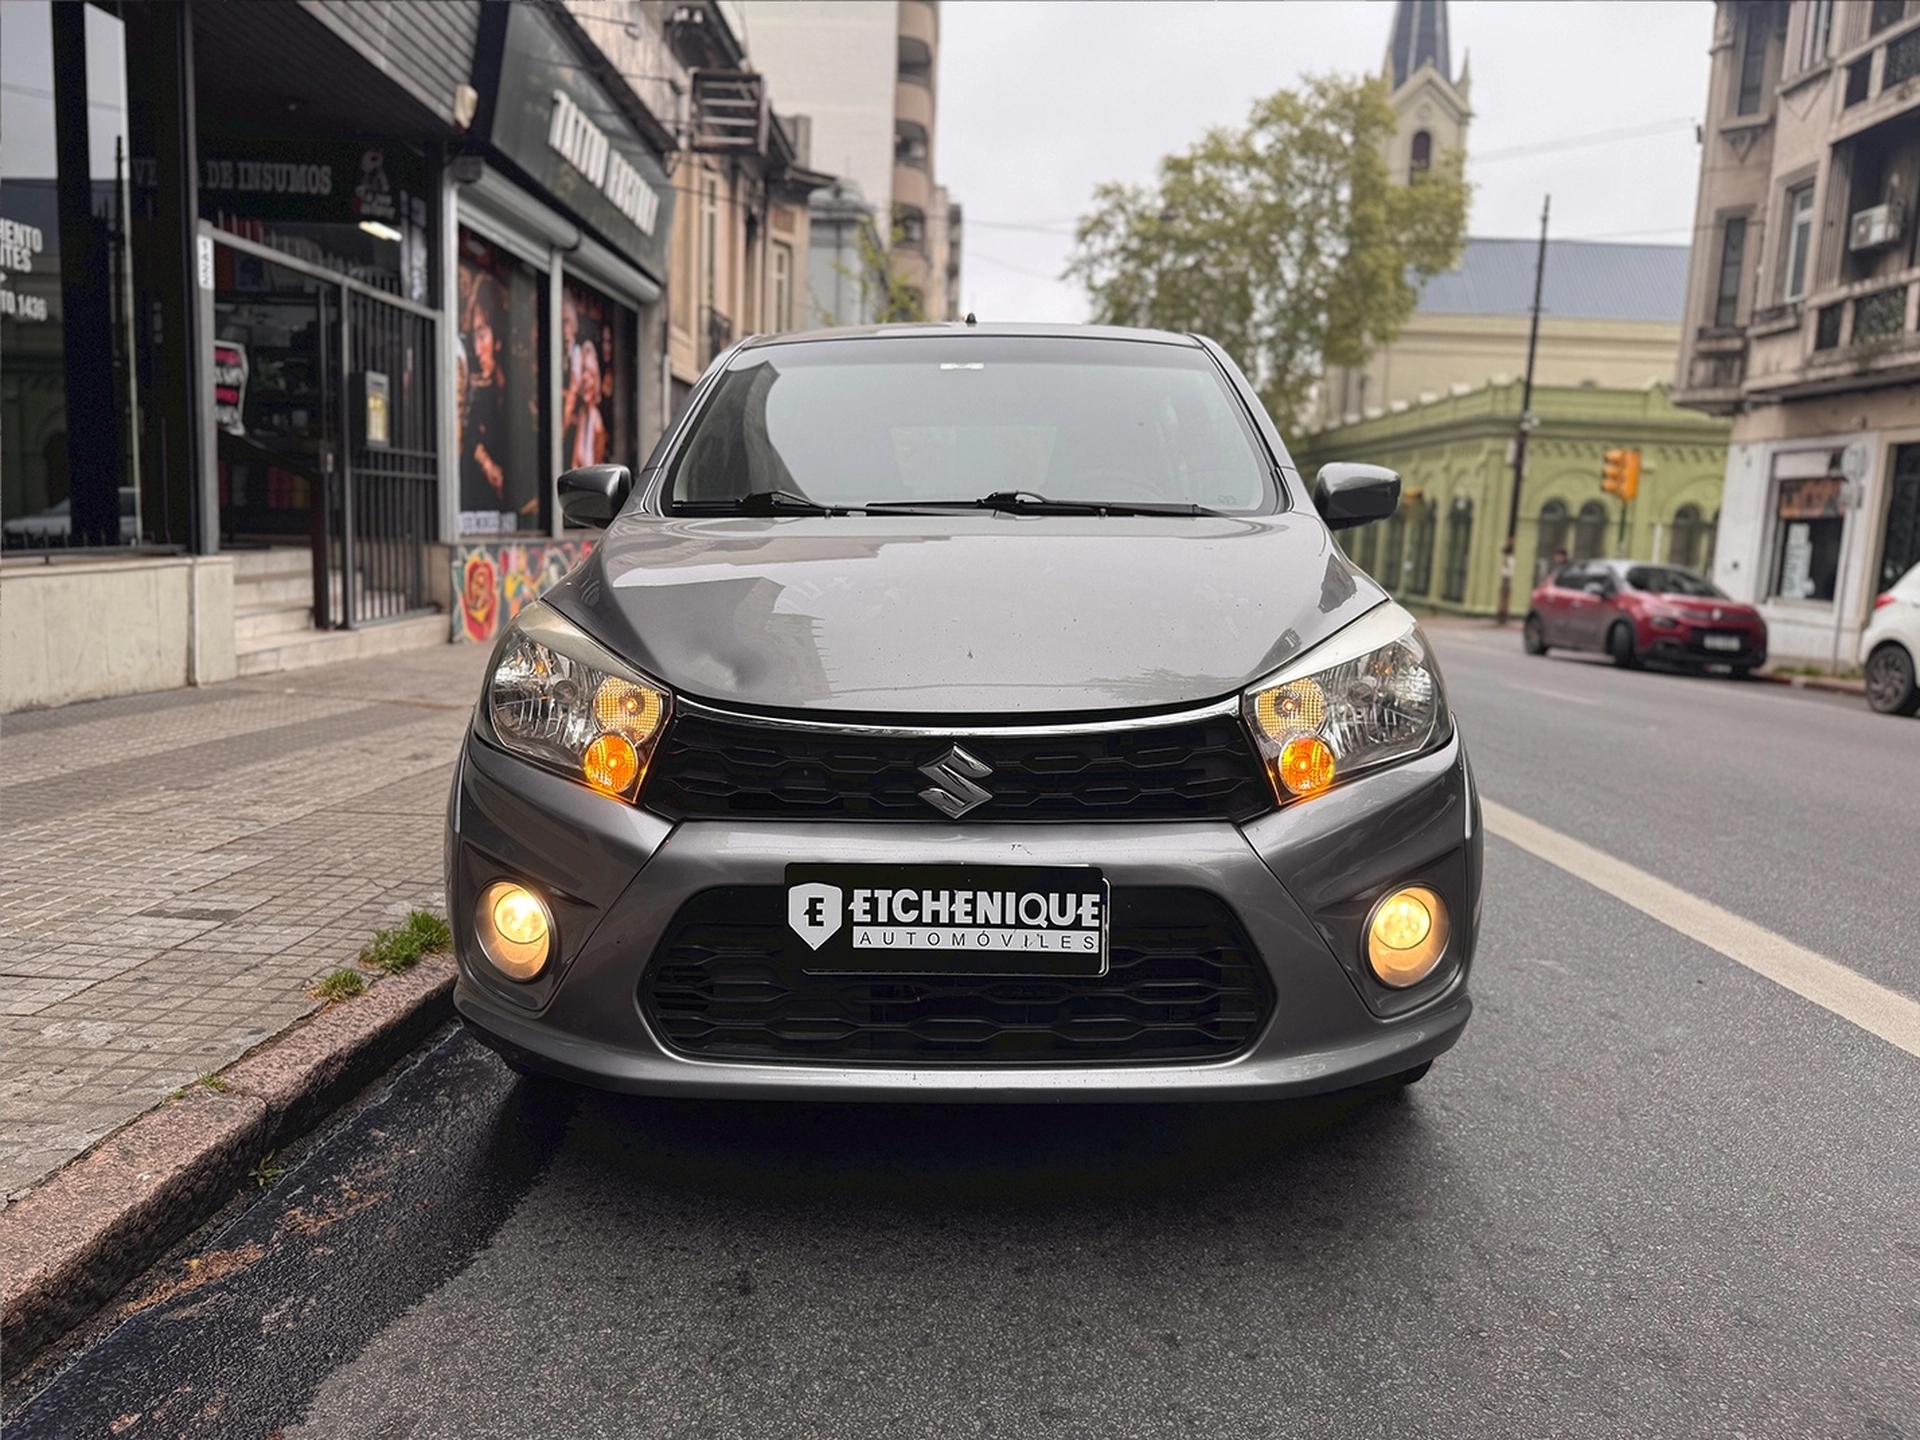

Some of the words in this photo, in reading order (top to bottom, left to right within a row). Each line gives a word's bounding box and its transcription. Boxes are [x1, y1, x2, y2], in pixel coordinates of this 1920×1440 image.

[206, 160, 234, 189] DE
[237, 161, 333, 196] INSUMOS
[848, 888, 1101, 929] ETCHENIQUE
[859, 931, 1095, 949] AUTOMÓVILES
